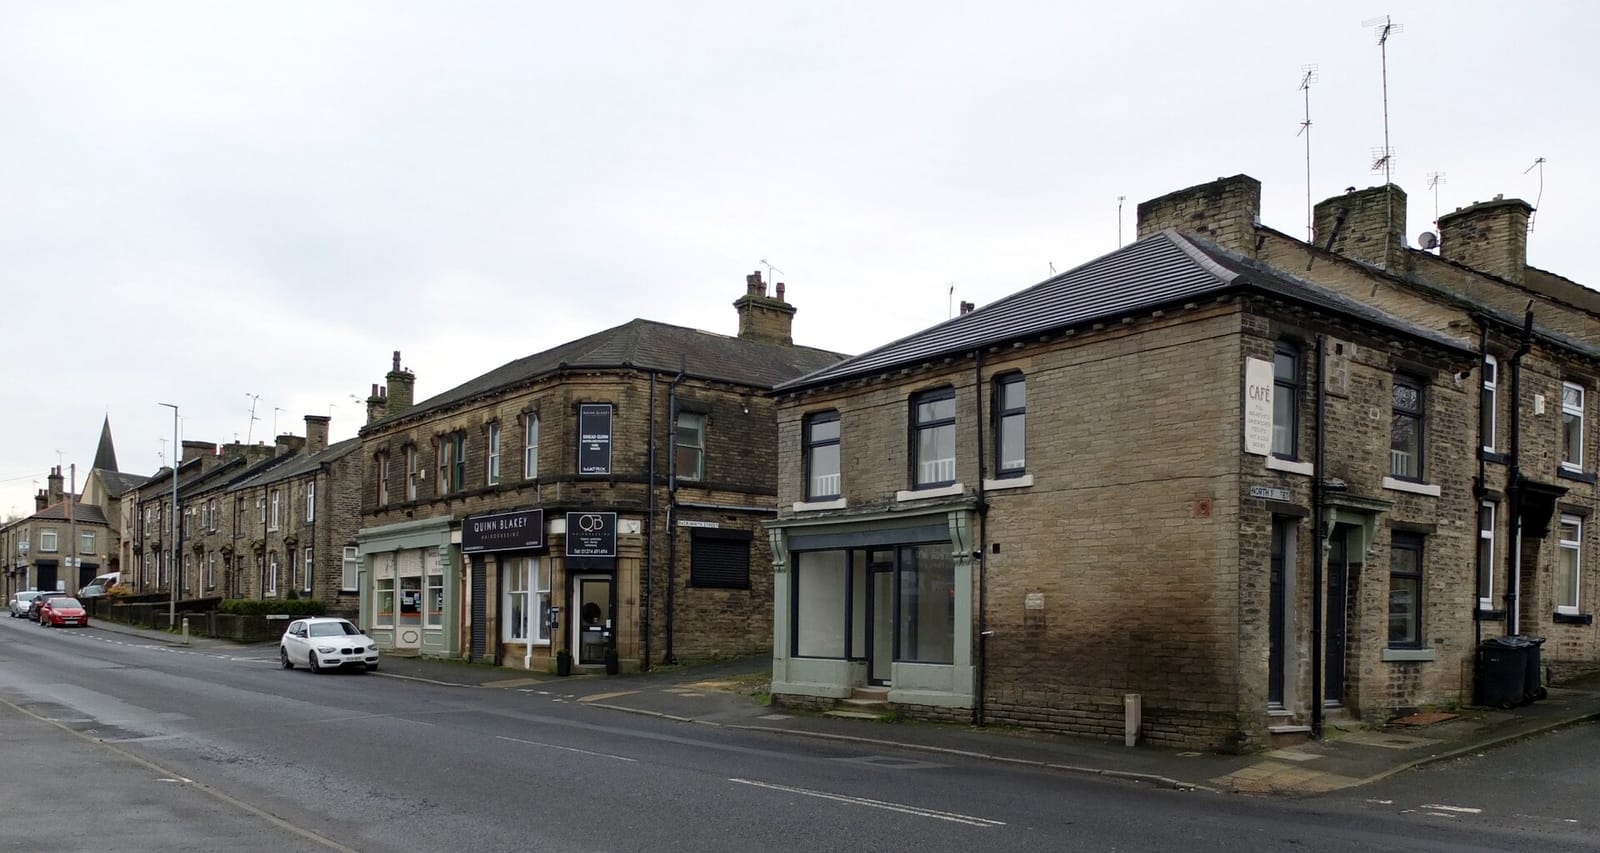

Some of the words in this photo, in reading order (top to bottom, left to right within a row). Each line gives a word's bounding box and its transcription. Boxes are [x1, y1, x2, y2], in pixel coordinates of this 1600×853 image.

[1249, 384, 1270, 402] CAFÉ
[474, 520, 497, 532] QUINN
[500, 516, 528, 530] BLAKEY
[578, 514, 604, 533] QB
